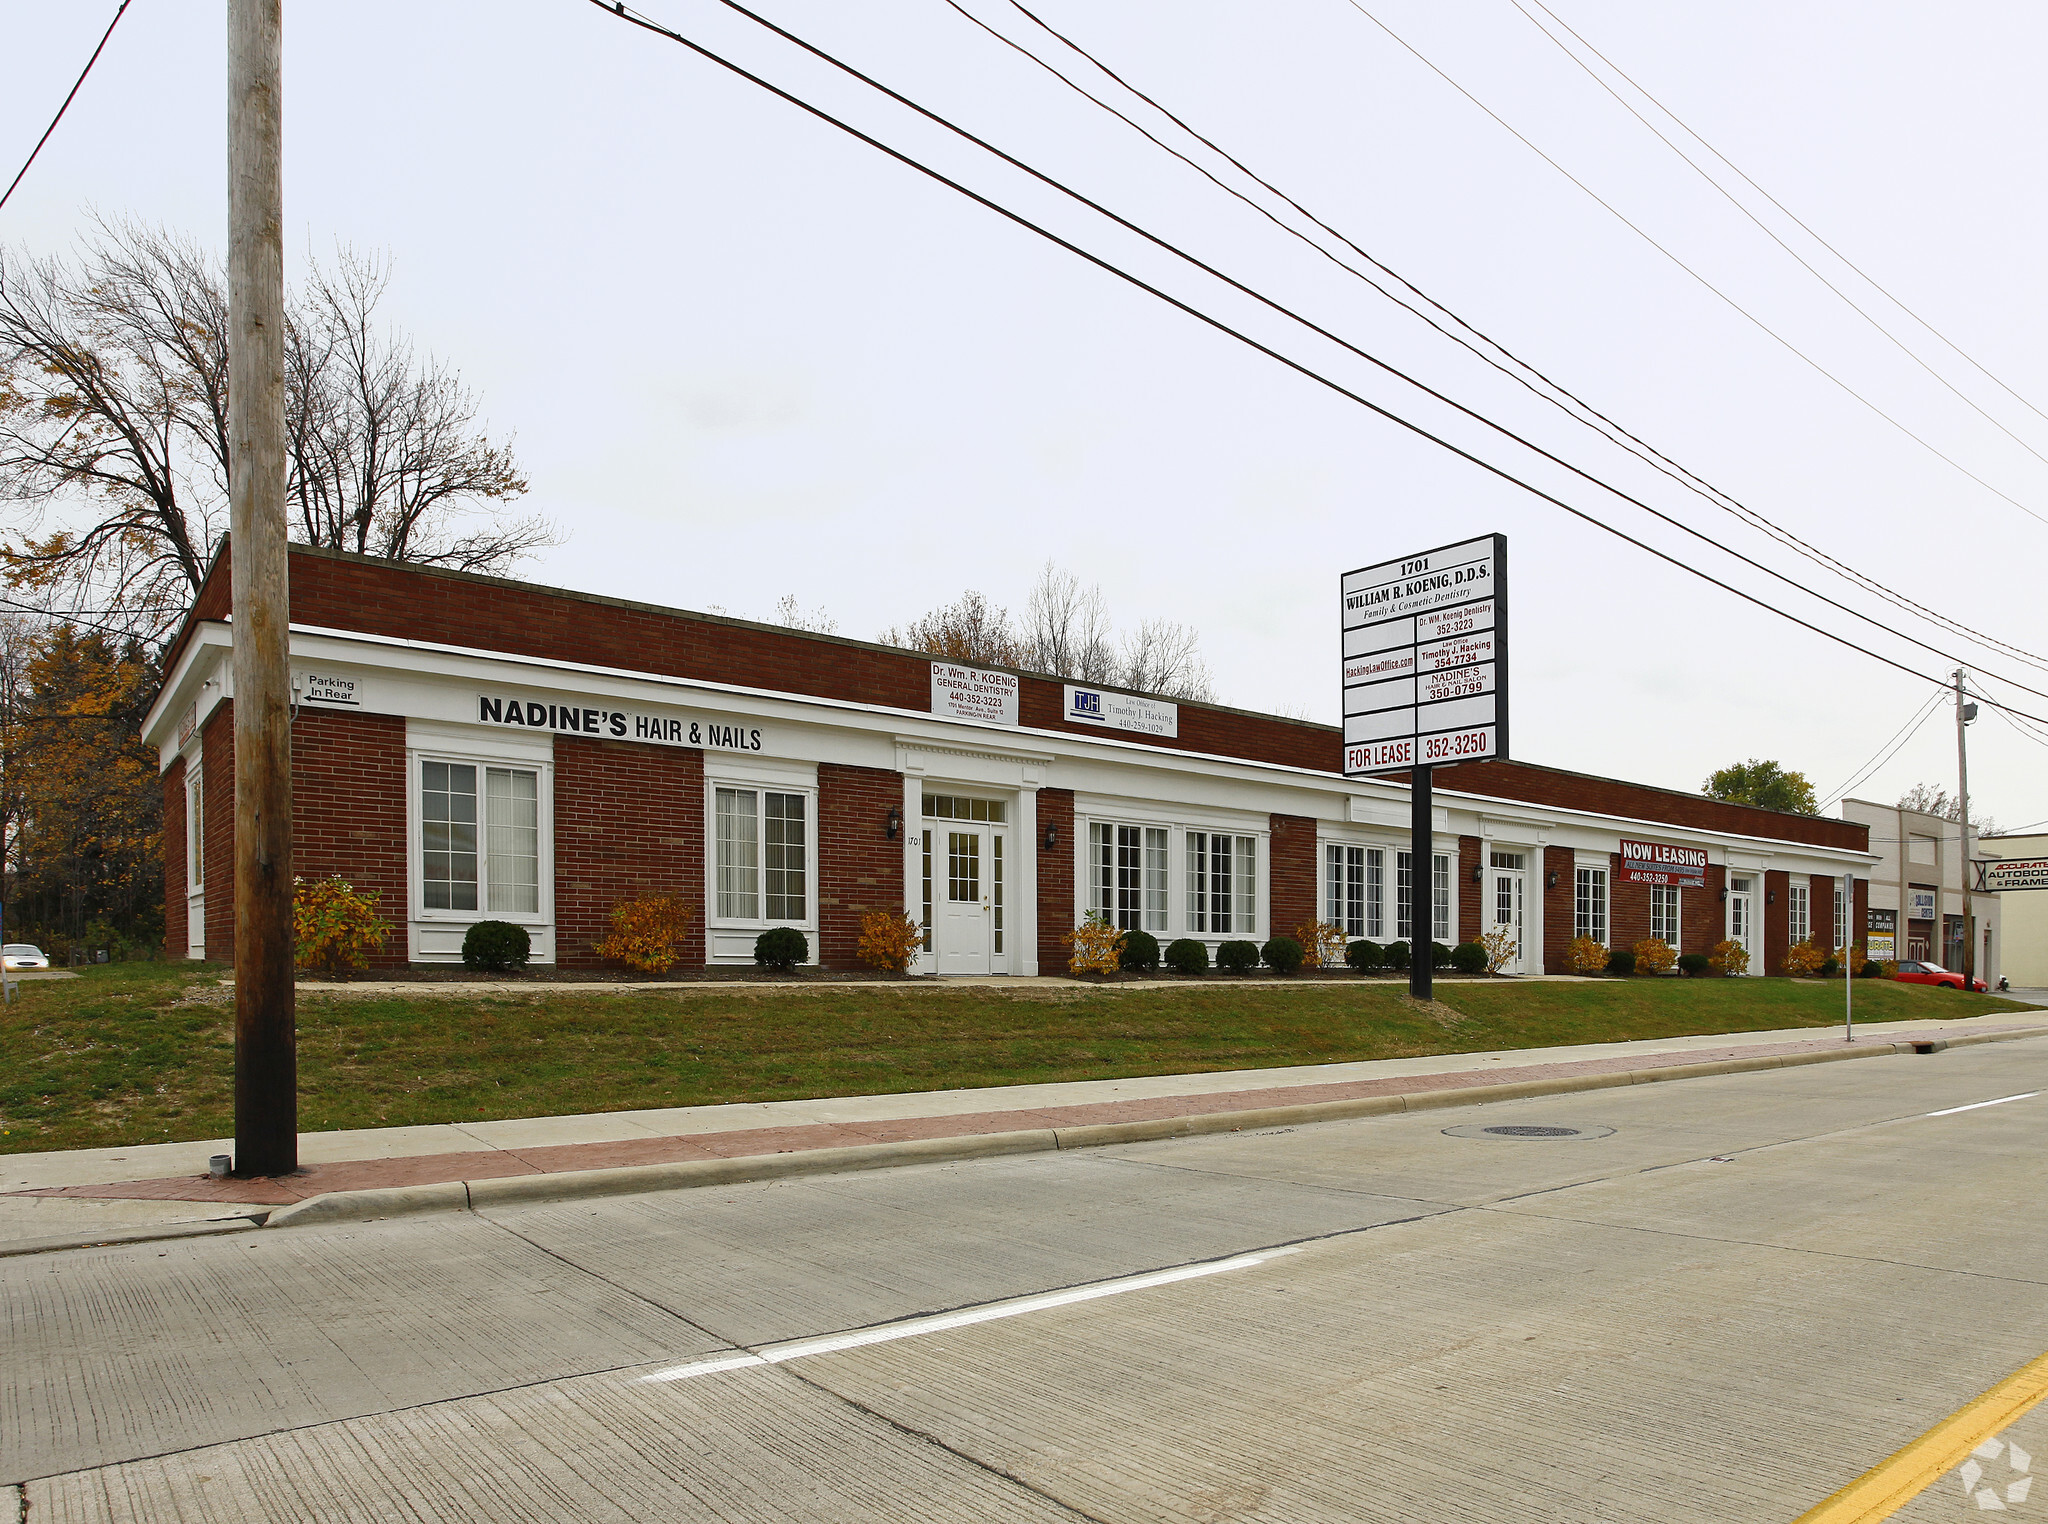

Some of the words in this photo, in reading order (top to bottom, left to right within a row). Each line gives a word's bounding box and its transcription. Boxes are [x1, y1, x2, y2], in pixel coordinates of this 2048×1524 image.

[1401, 558, 1429, 576] 1701
[1346, 588, 1390, 610] WILLIAM
[1393, 586, 1404, 599] R.
[1406, 574, 1452, 596] KOENIG,
[1455, 564, 1491, 584] D.D.S.
[1364, 606, 1389, 620] Family
[1389, 604, 1396, 613] &
[1398, 596, 1432, 610] Cosmetic
[1434, 588, 1472, 603] Dentistry
[1429, 615, 1441, 624] WM.
[1443, 610, 1462, 621] Koenig
[1464, 605, 1491, 616] Dentistry
[1436, 618, 1473, 635] 352-3223
[1422, 648, 1450, 660] Timothy
[1452, 646, 1458, 655] J.
[1460, 642, 1491, 653] Hacking
[1435, 652, 1477, 668] 354-7734
[933, 665, 945, 676] Dr.
[948, 667, 967, 680] Wm.
[970, 671, 979, 681] R.
[982, 673, 1016, 687] KOENIG
[1346, 657, 1413, 678] HackingLawOffice.com
[1432, 667, 1480, 683] NADINE'S
[309, 675, 354, 690] Parking
[937, 678, 972, 691] GENERAL
[974, 684, 1014, 697] DENTISTRY
[1464, 675, 1487, 683] SALON
[311, 687, 322, 696] In
[326, 689, 352, 699] Rear
[950, 692, 1002, 707] 440-352-3223
[1430, 682, 1482, 699] 350-0799
[1076, 692, 1099, 711] TJH
[1137, 699, 1150, 707] Office
[956, 709, 977, 717] PARKING
[1108, 704, 1136, 719] Timothy
[1138, 709, 1143, 718] J.
[1145, 710, 1173, 726] Hacking
[480, 697, 627, 736] NADINE'S
[636, 716, 682, 742] HAIR
[689, 722, 702, 744] &
[708, 724, 761, 751] NAILS
[1119, 720, 1163, 733] 440-259-1029
[1349, 748, 1371, 768] FOR
[1375, 743, 1411, 765] LEASE
[1426, 732, 1487, 759] 352-3250
[1623, 842, 1652, 860] NOW
[1655, 846, 1706, 867] LEASING
[1630, 871, 1668, 884] 440-352-3250
